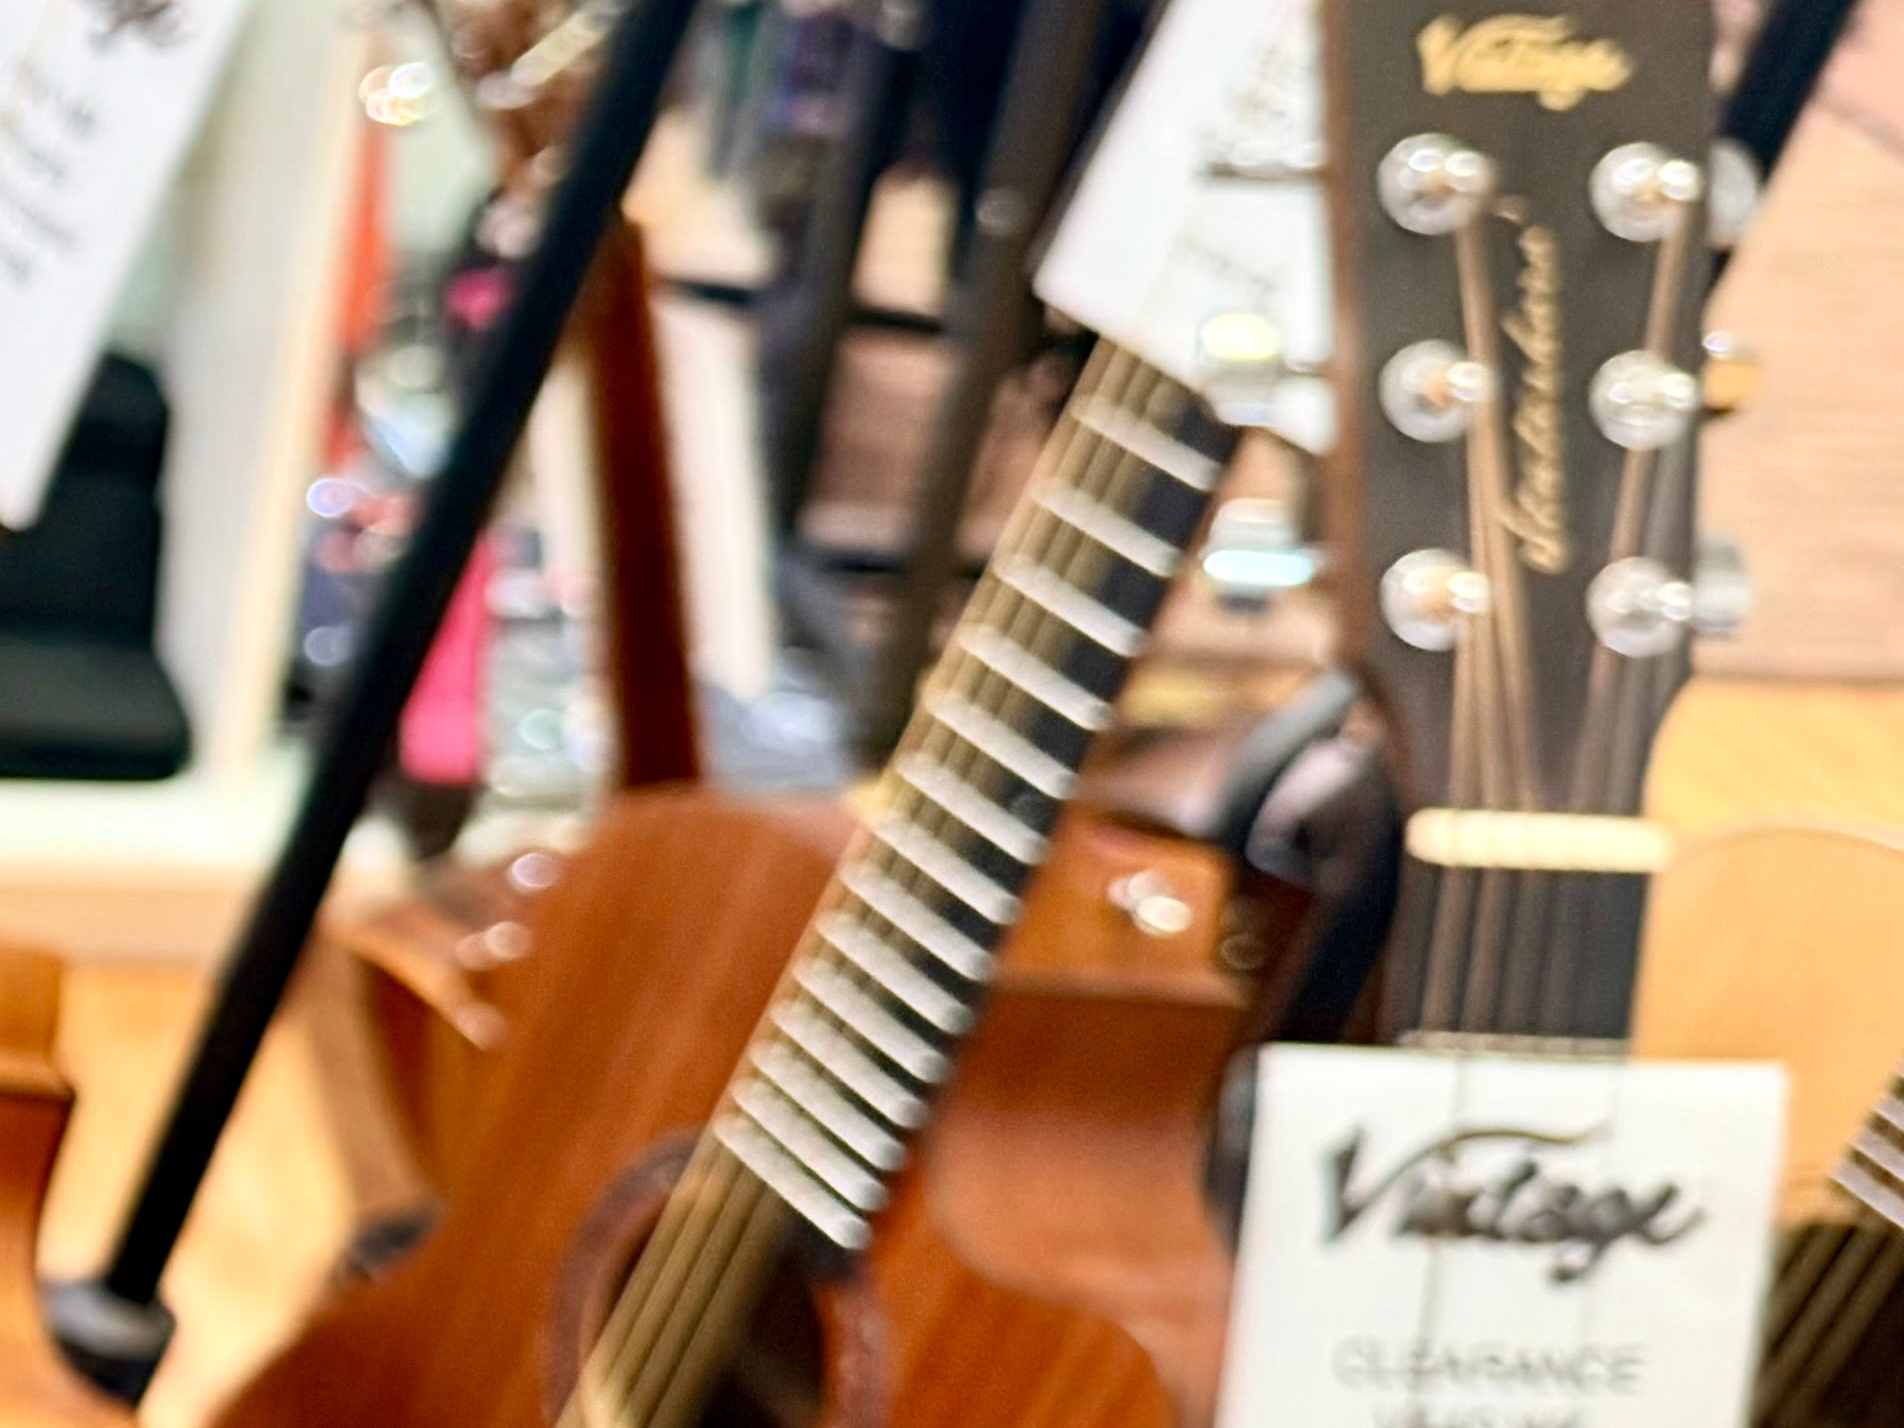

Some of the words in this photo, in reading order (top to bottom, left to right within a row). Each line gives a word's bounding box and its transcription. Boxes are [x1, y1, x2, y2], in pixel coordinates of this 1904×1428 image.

[1416, 13, 1635, 112] Vintage
[1318, 1120, 1705, 1285] Vintage
[1337, 1342, 1638, 1391] CLEARANCE
